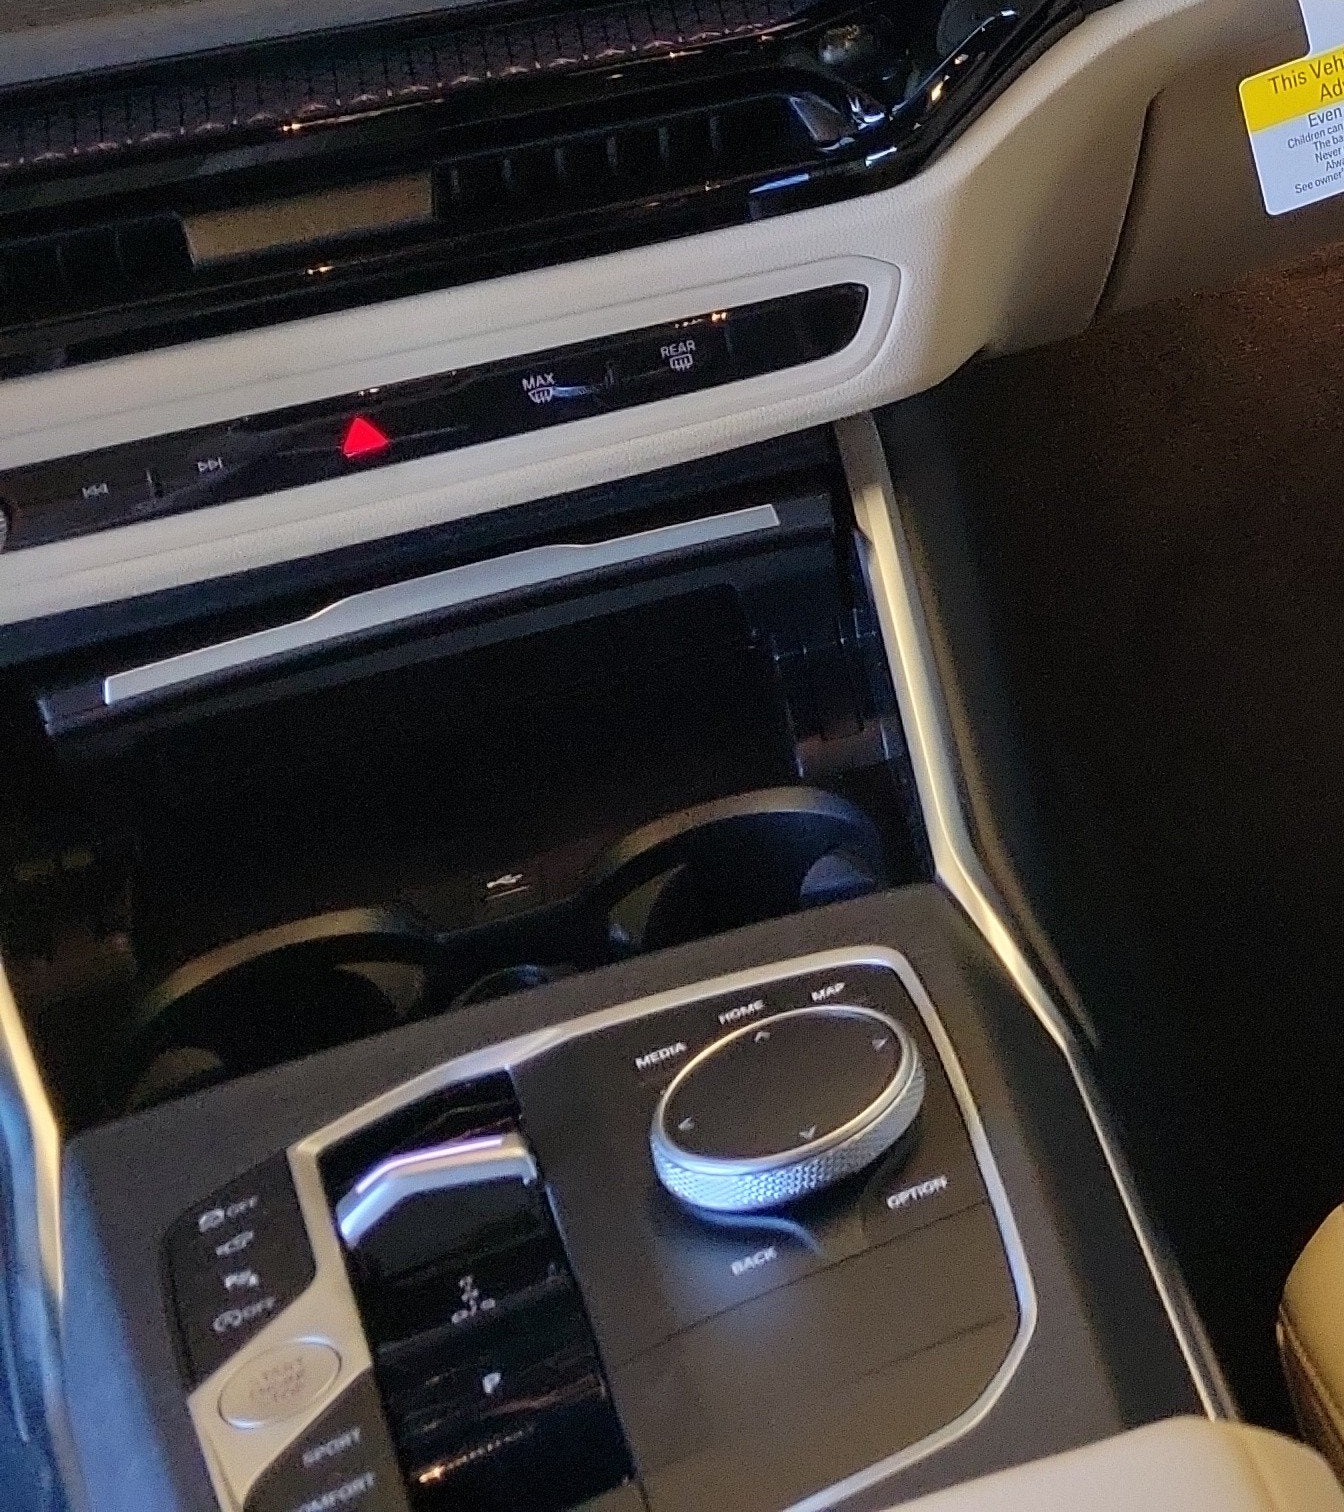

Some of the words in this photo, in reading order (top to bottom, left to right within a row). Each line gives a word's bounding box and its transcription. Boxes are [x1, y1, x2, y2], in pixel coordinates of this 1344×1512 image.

[1268, 72, 1307, 95] This
[1308, 107, 1342, 128] Even
[1287, 130, 1326, 149] Children
[1327, 122, 1344, 134] can
[1313, 139, 1331, 151] The
[1315, 149, 1341, 163] Never
[1295, 183, 1313, 193] See
[660, 339, 696, 358] REAR
[522, 373, 556, 391] MAX
[811, 981, 846, 1002] MAP
[717, 999, 766, 1025] HOME
[635, 1040, 687, 1070] MEDIA
[886, 1175, 948, 1210] OPTION
[730, 1245, 779, 1276] BACK
